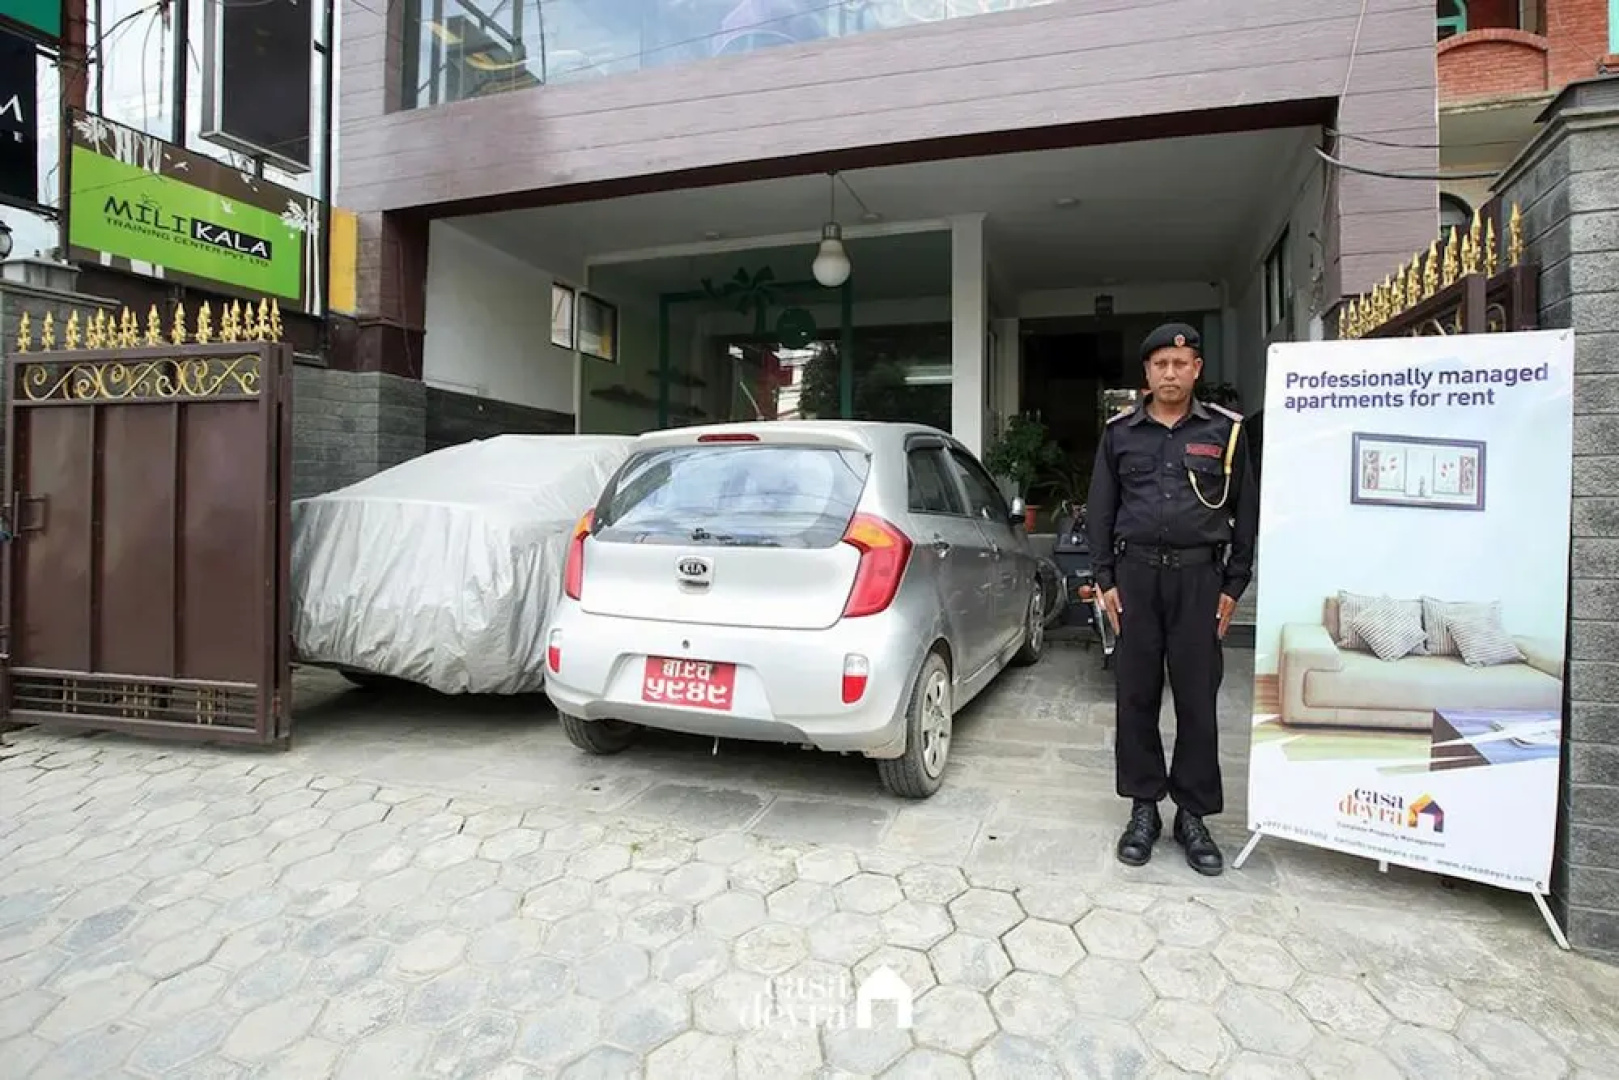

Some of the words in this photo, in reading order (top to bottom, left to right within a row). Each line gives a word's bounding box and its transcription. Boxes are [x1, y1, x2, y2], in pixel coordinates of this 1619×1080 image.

[104, 195, 188, 234] MILI
[195, 221, 268, 259] KALA
[106, 217, 170, 241] TRAINING
[1285, 367, 1433, 389] Professionally
[1438, 362, 1549, 387] managed
[1284, 392, 1404, 414] apartments
[1409, 389, 1441, 407] for
[1447, 388, 1495, 406] rent
[1338, 794, 1403, 826] deyra
[1354, 788, 1404, 810] casa
